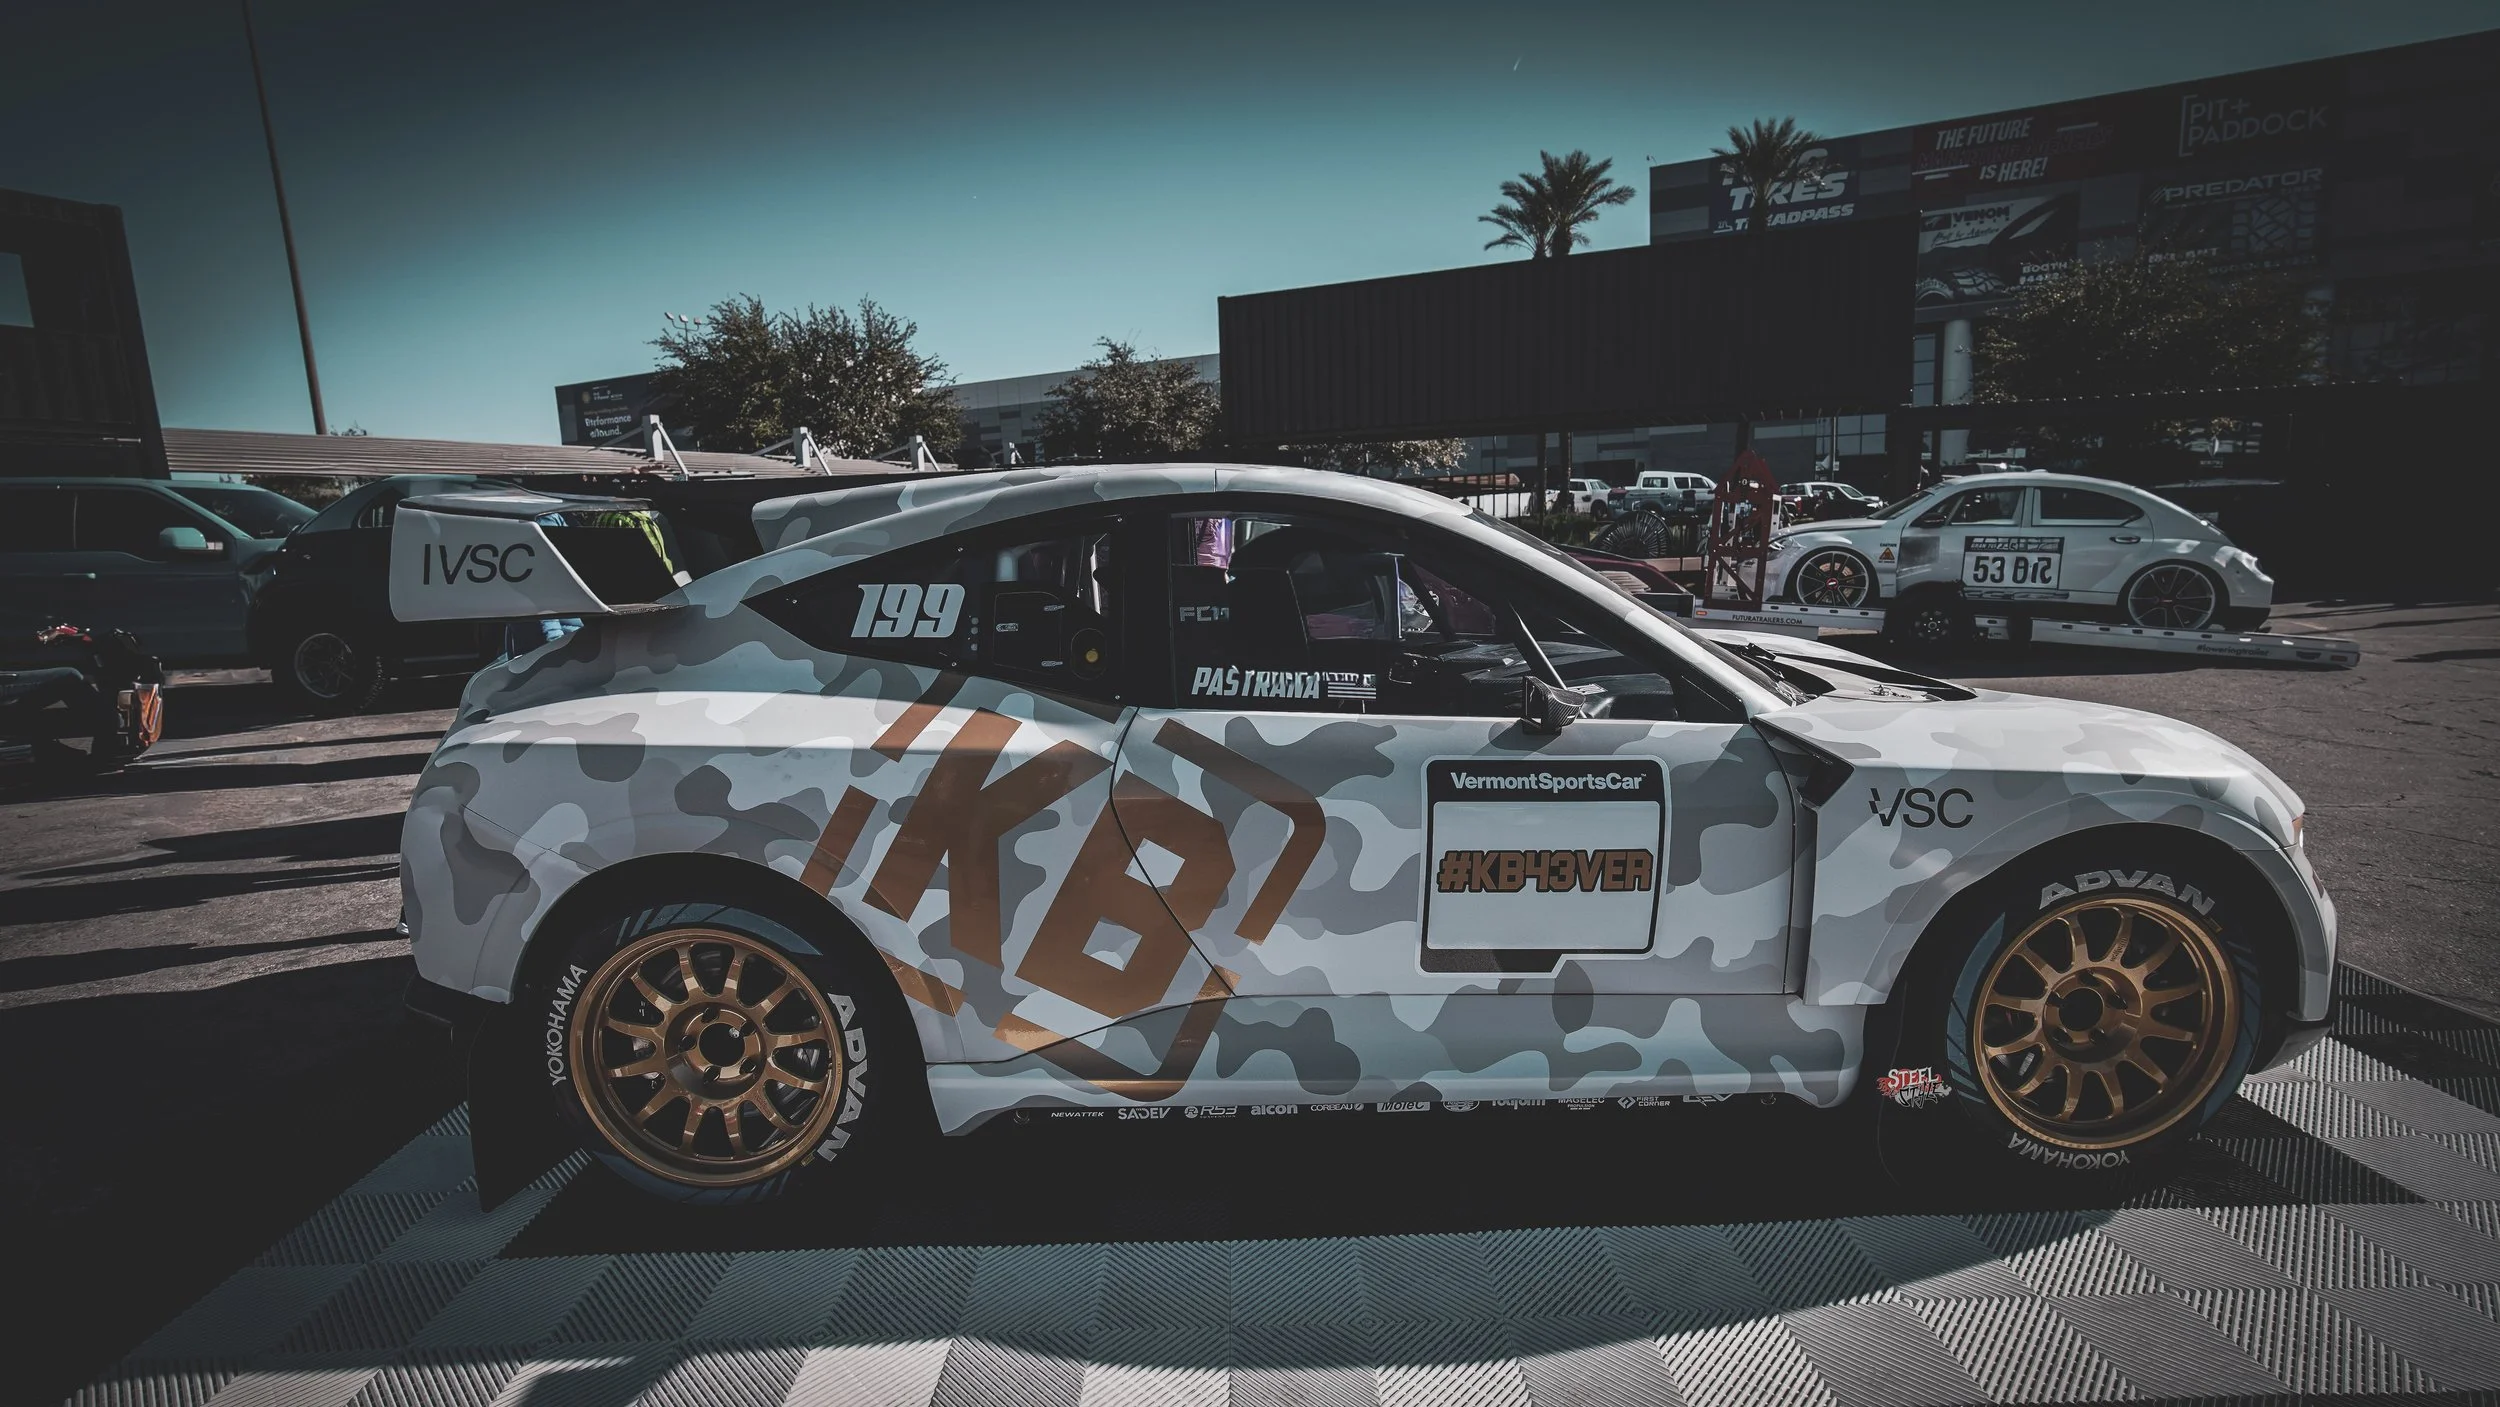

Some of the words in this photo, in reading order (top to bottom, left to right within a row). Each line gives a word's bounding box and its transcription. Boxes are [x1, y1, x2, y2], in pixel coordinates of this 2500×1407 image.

[2188, 105, 2329, 147] PADDOCK
[2190, 97, 2250, 124] PIT+
[1935, 126, 1966, 150] THE
[1967, 116, 2035, 147] FUTURE
[1979, 164, 1997, 180] IS
[1996, 156, 2049, 182] HERE!
[2164, 168, 2324, 201] PREDATOR
[851, 583, 966, 638] 199
[1731, 614, 1803, 625] FUTURATRAILERS.COM
[1868, 787, 1975, 829] VSC
[1438, 849, 1653, 892] #KB43VER
[2039, 869, 2216, 916] ADVAN
[548, 963, 589, 1087] YOKOHAMA
[817, 992, 868, 1162] ADVAN
[1888, 1066, 1941, 1088] STEEL
[1117, 1107, 1171, 1120] SADEV
[1250, 1103, 1299, 1116] alcon
[1310, 1103, 1353, 1112] CORBEAU
[2007, 1131, 2131, 1170] YOKOHAMA
